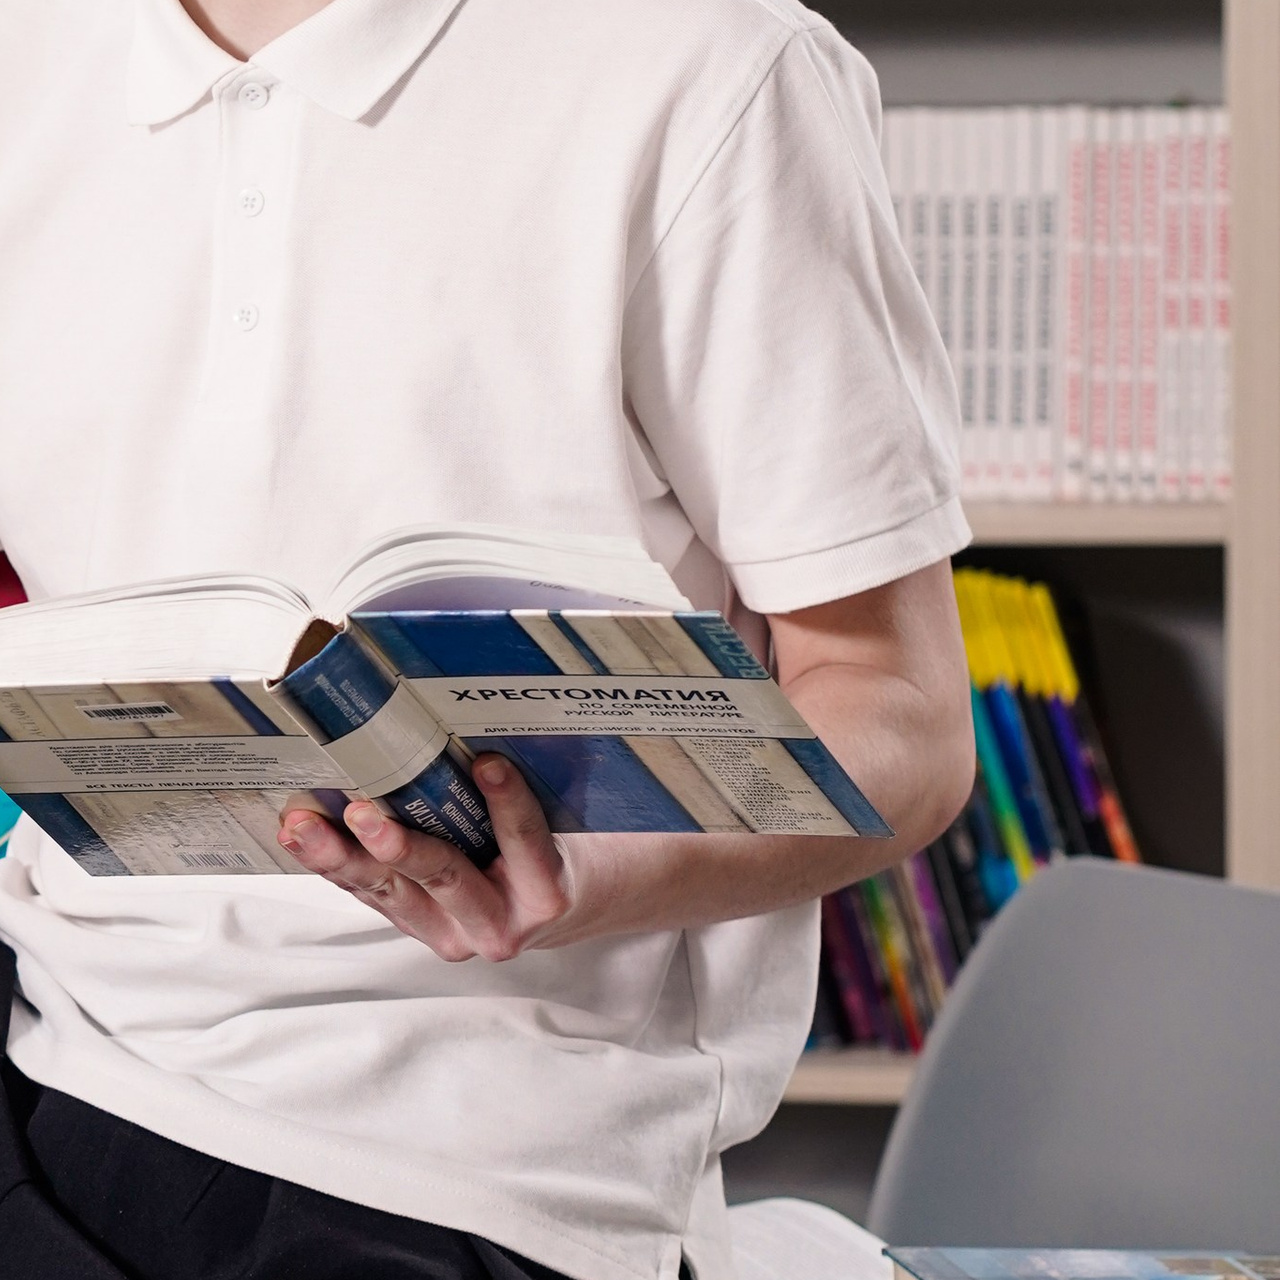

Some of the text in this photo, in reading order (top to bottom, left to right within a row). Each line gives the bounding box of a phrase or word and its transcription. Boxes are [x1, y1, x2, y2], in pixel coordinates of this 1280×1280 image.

[449, 688, 731, 702] ХРЕСТОМАТИЯ
[579, 702, 738, 711] ПО СОВРЕМЕННОЙ
[649, 710, 744, 719] ЛИТЕРАТУРЕ
[484, 726, 509, 734] ДЛЯ
[662, 726, 756, 735] АБИТУРИЕНТОВ
[448, 779, 486, 821] ЛИТЕРАТУРЕ
[440, 801, 485, 848] СОВРЕМЕННОЙ
